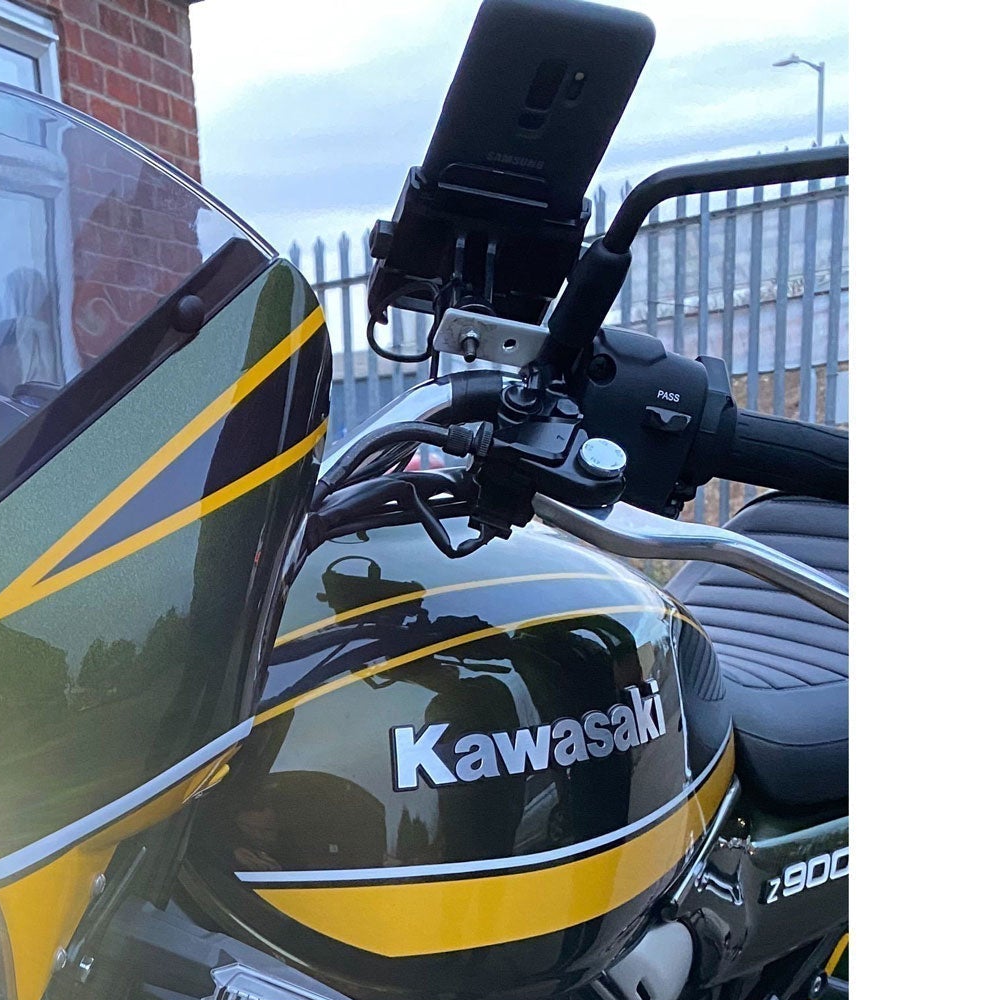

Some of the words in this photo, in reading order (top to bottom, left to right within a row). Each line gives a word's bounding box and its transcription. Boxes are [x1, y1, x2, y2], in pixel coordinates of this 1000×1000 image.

[486, 151, 546, 169] SAMSUNG
[656, 390, 681, 403] PASS
[390, 678, 668, 792] Kawasaki
[766, 846, 850, 904] Z900
